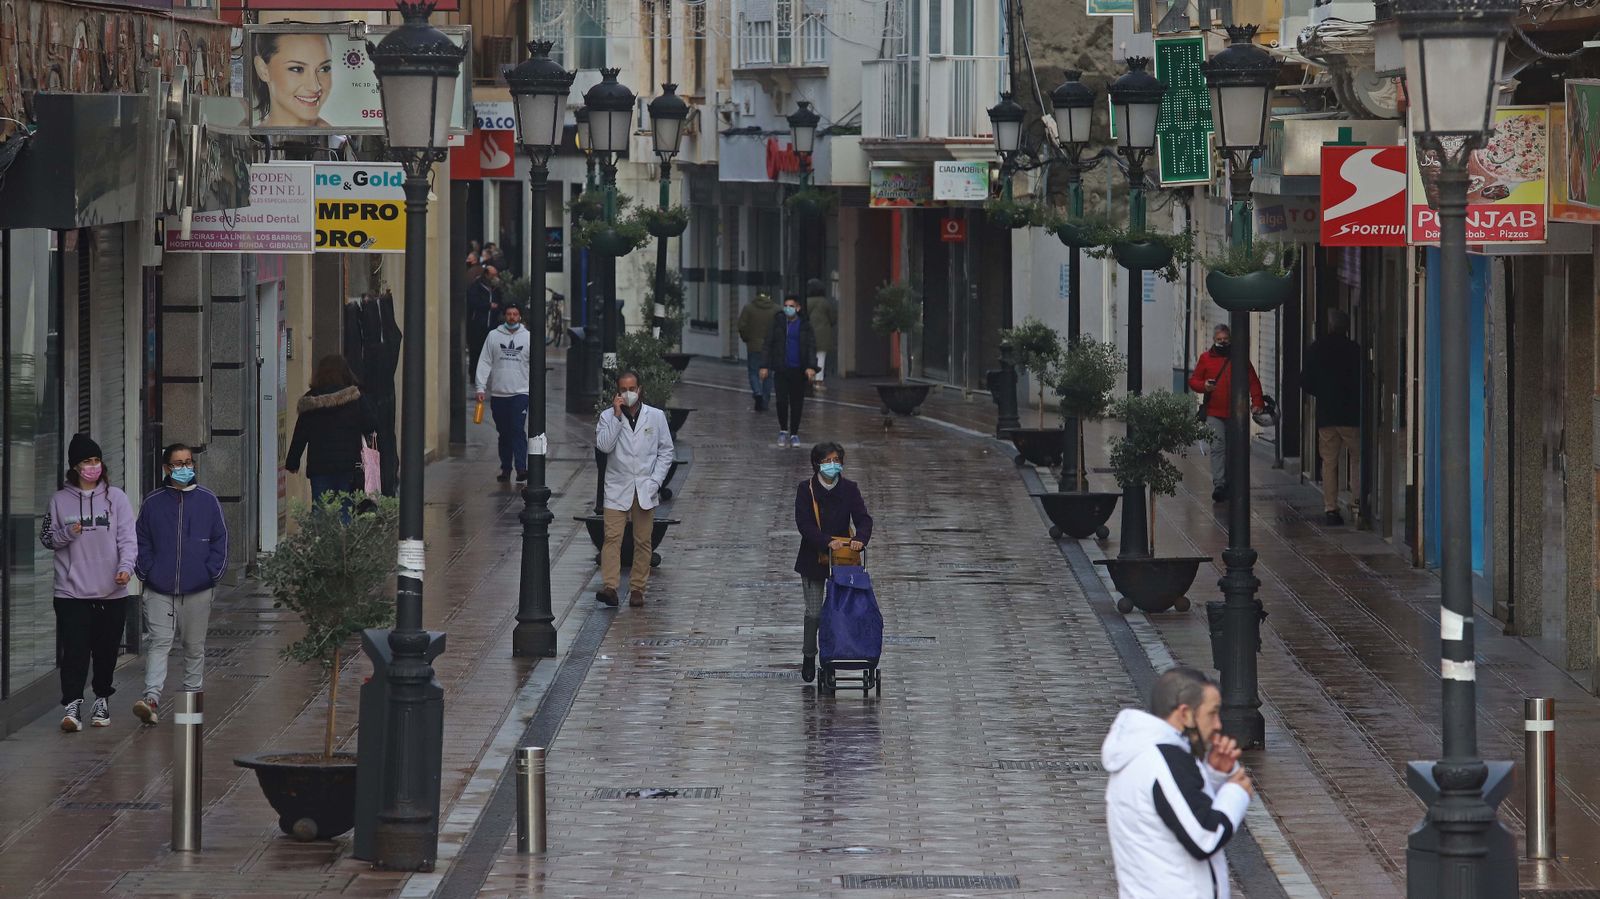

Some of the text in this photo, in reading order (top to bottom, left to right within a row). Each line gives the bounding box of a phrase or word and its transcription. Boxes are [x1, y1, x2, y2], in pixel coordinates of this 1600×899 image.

[361, 109, 383, 119] 956
[343, 181, 352, 191] &
[353, 171, 402, 187] Gold
[315, 203, 399, 221] MPRO
[235, 214, 264, 223] Salud
[266, 214, 300, 223] Dental
[1499, 229, 1529, 238] Pizzas
